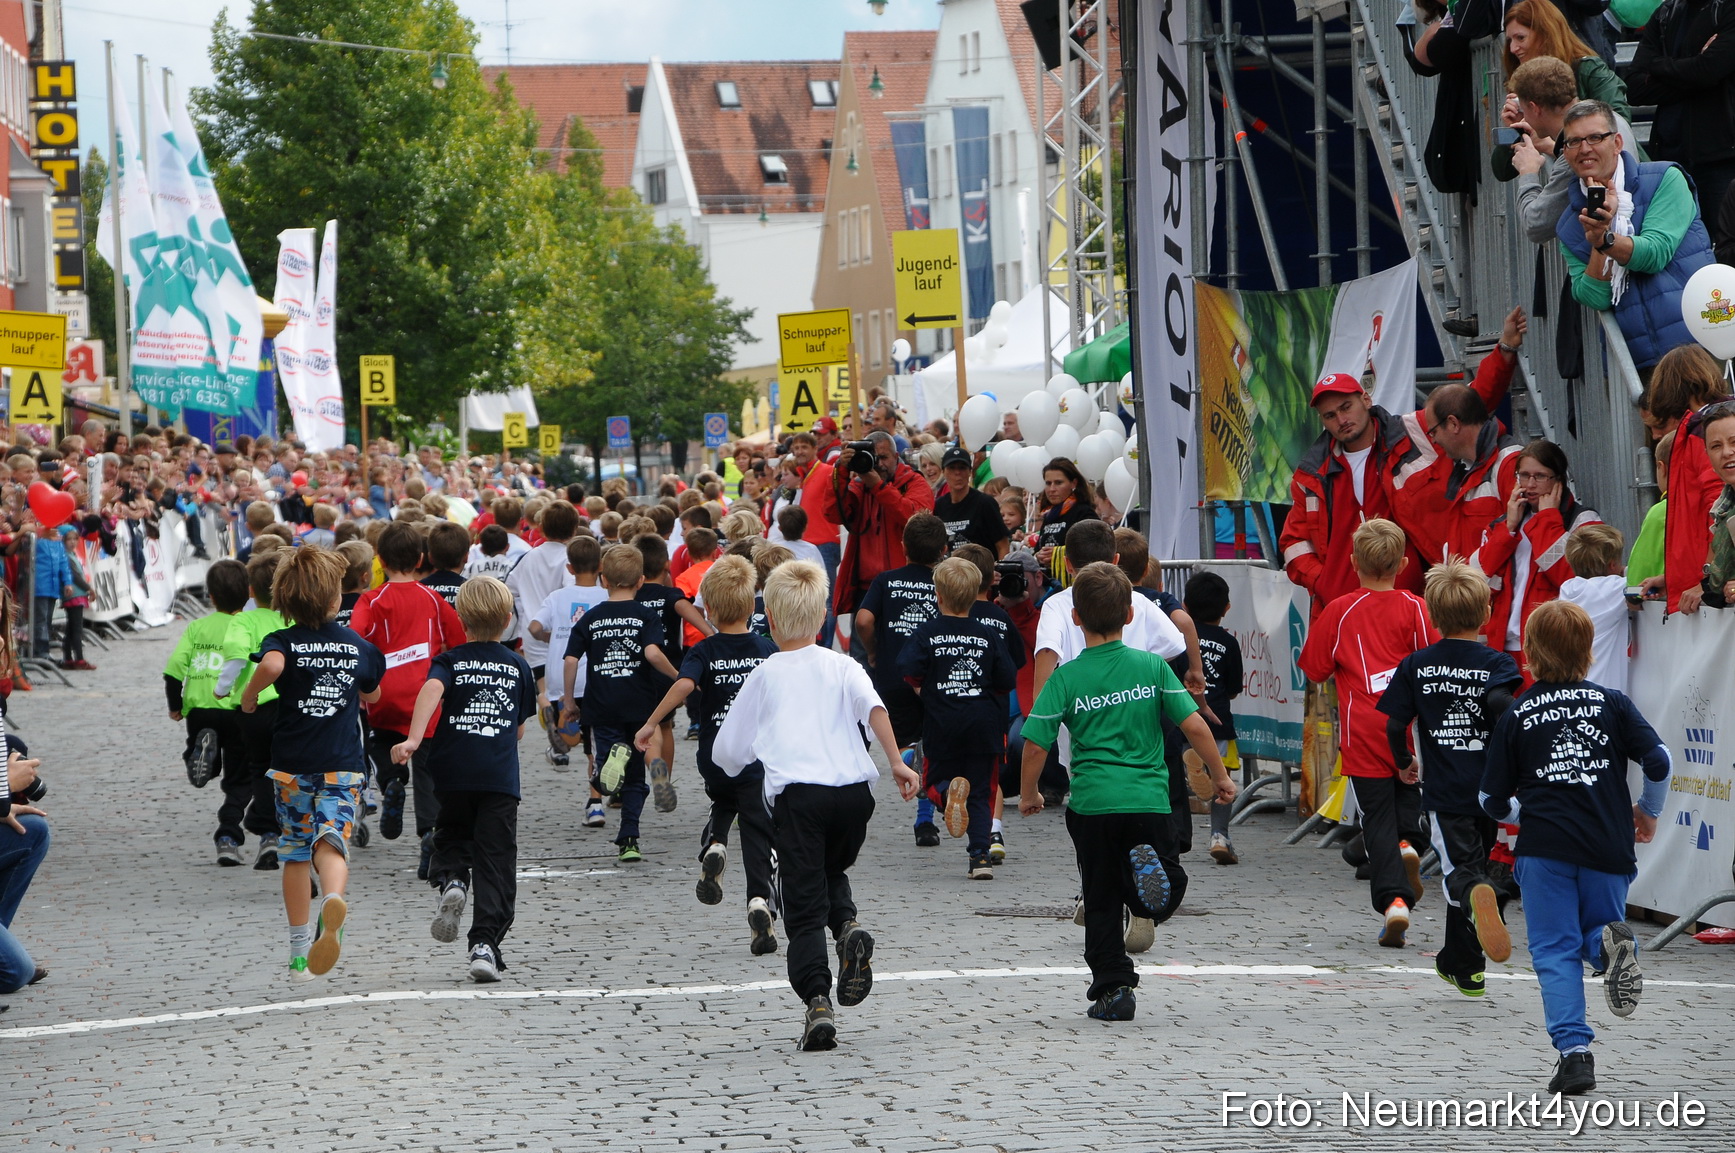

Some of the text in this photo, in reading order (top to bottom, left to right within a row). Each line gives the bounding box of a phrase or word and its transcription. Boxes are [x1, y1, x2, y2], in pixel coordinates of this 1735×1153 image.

[36, 65, 82, 286] HOTEL
[896, 255, 958, 275] Jugend-
[914, 275, 942, 290] lauf
[783, 326, 846, 341] Schnupper-
[11, 343, 36, 355] lauf
[805, 341, 826, 353] lauf
[364, 358, 389, 367] Block
[21, 371, 50, 407] A
[370, 371, 385, 393] B
[790, 380, 819, 416] A
[508, 422, 521, 439] C
[545, 434, 555, 449] D
[610, 437, 630, 446] TAXI
[707, 436, 726, 446] TAXI
[477, 561, 508, 573] LAHM
[588, 617, 644, 631] NEUMARKTER
[976, 617, 1008, 631] ARKTER
[592, 629, 639, 641] STADTLAUF
[929, 634, 989, 648] NEUMARKTER
[290, 642, 360, 656] NEUMARKTER
[622, 637, 642, 654] 2013
[1198, 638, 1227, 654] RKTER
[296, 657, 359, 669] STADTLAUF
[397, 649, 417, 662] DEHN
[453, 660, 520, 679] NEUMARKTER
[966, 657, 983, 676] 2013
[336, 670, 355, 690] 201
[455, 674, 516, 690] STADTLAUF
[714, 672, 751, 685] STADT
[298, 698, 333, 708] BMBINI
[494, 687, 515, 712] 2013
[1074, 684, 1156, 715] Alexander
[1513, 688, 1606, 718] NEUMARKTER
[1464, 698, 1485, 720] 201
[449, 715, 512, 728] BAMBINI LAUF
[1523, 705, 1602, 731] STADTLAUF
[1576, 720, 1609, 746] 2013
[1581, 759, 1610, 770] LAUF
